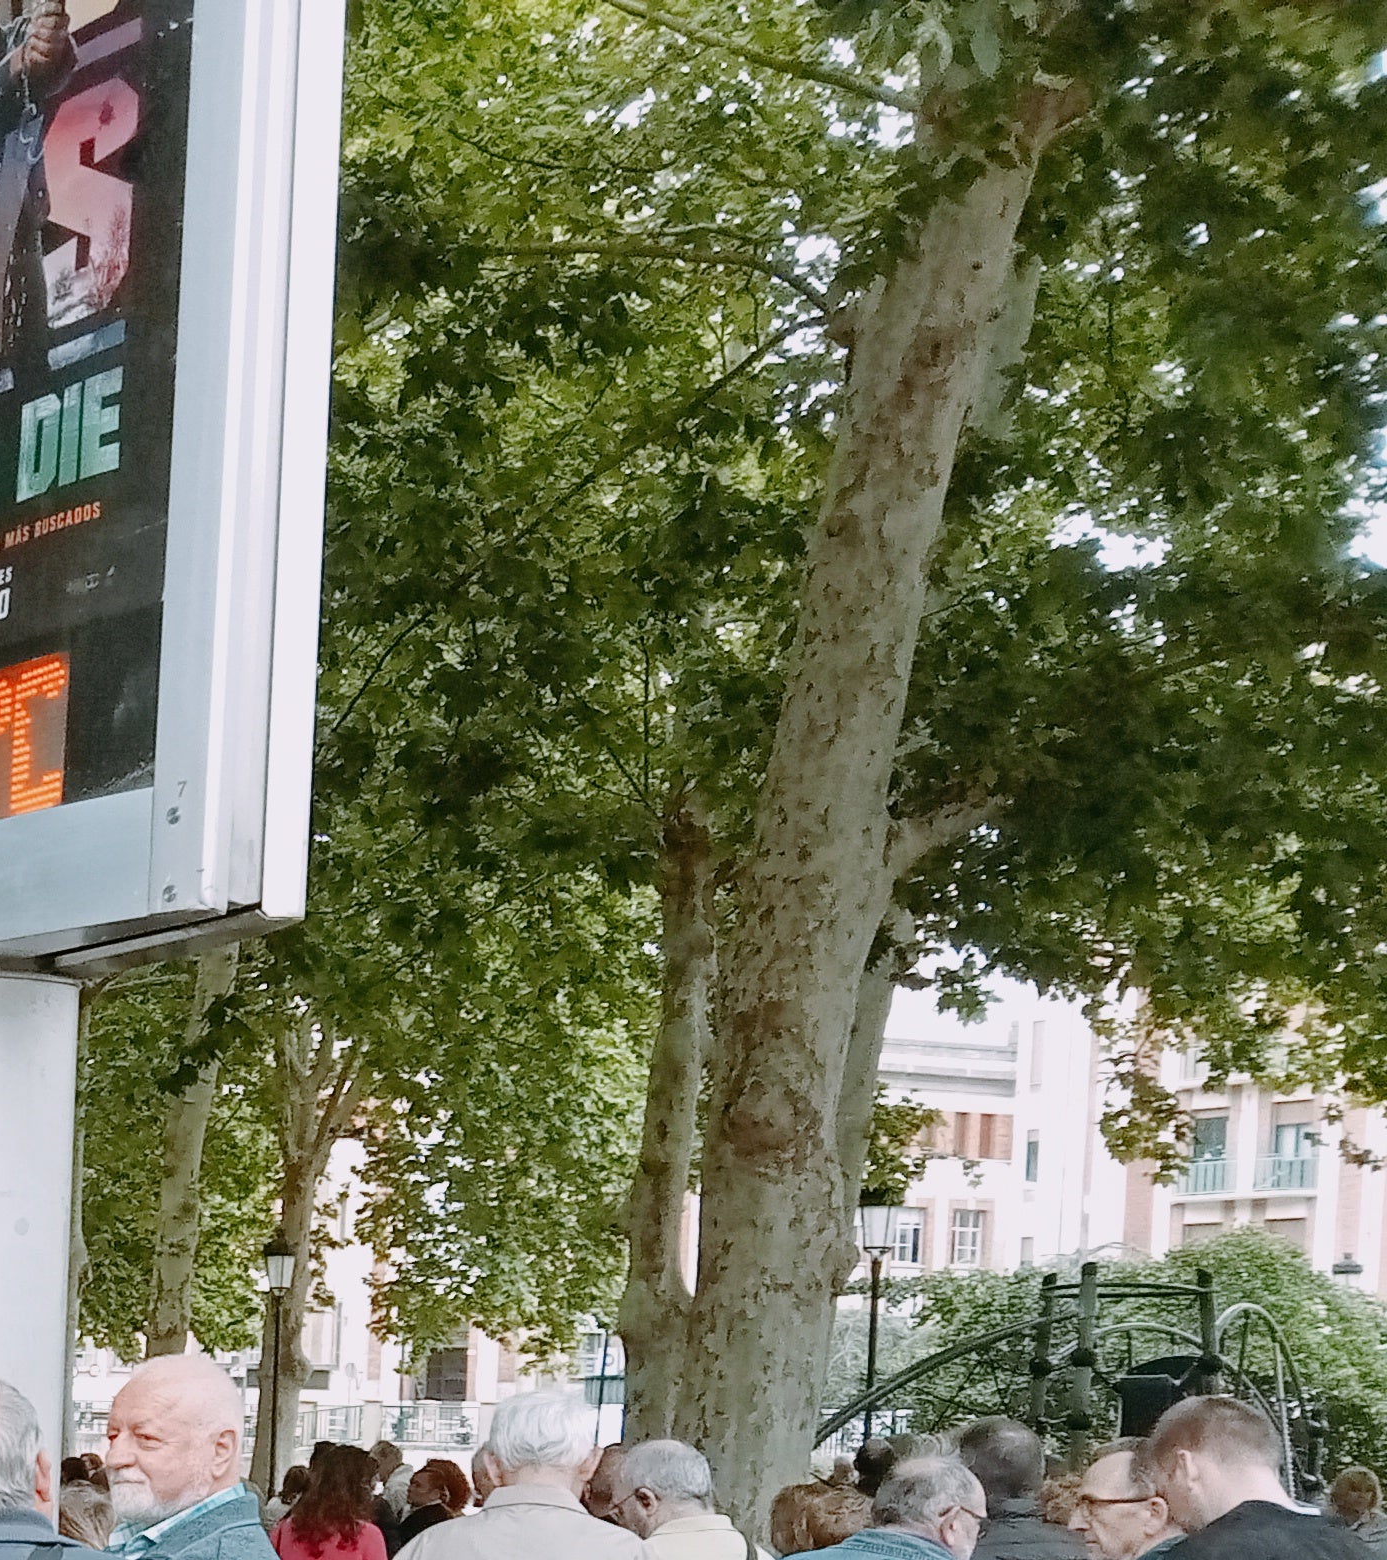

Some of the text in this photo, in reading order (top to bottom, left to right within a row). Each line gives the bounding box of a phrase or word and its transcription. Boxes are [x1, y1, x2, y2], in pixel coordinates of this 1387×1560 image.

[15, 366, 124, 503] DIE
[4, 524, 30, 550] MÁS
[33, 501, 102, 538] BUSCADOS
